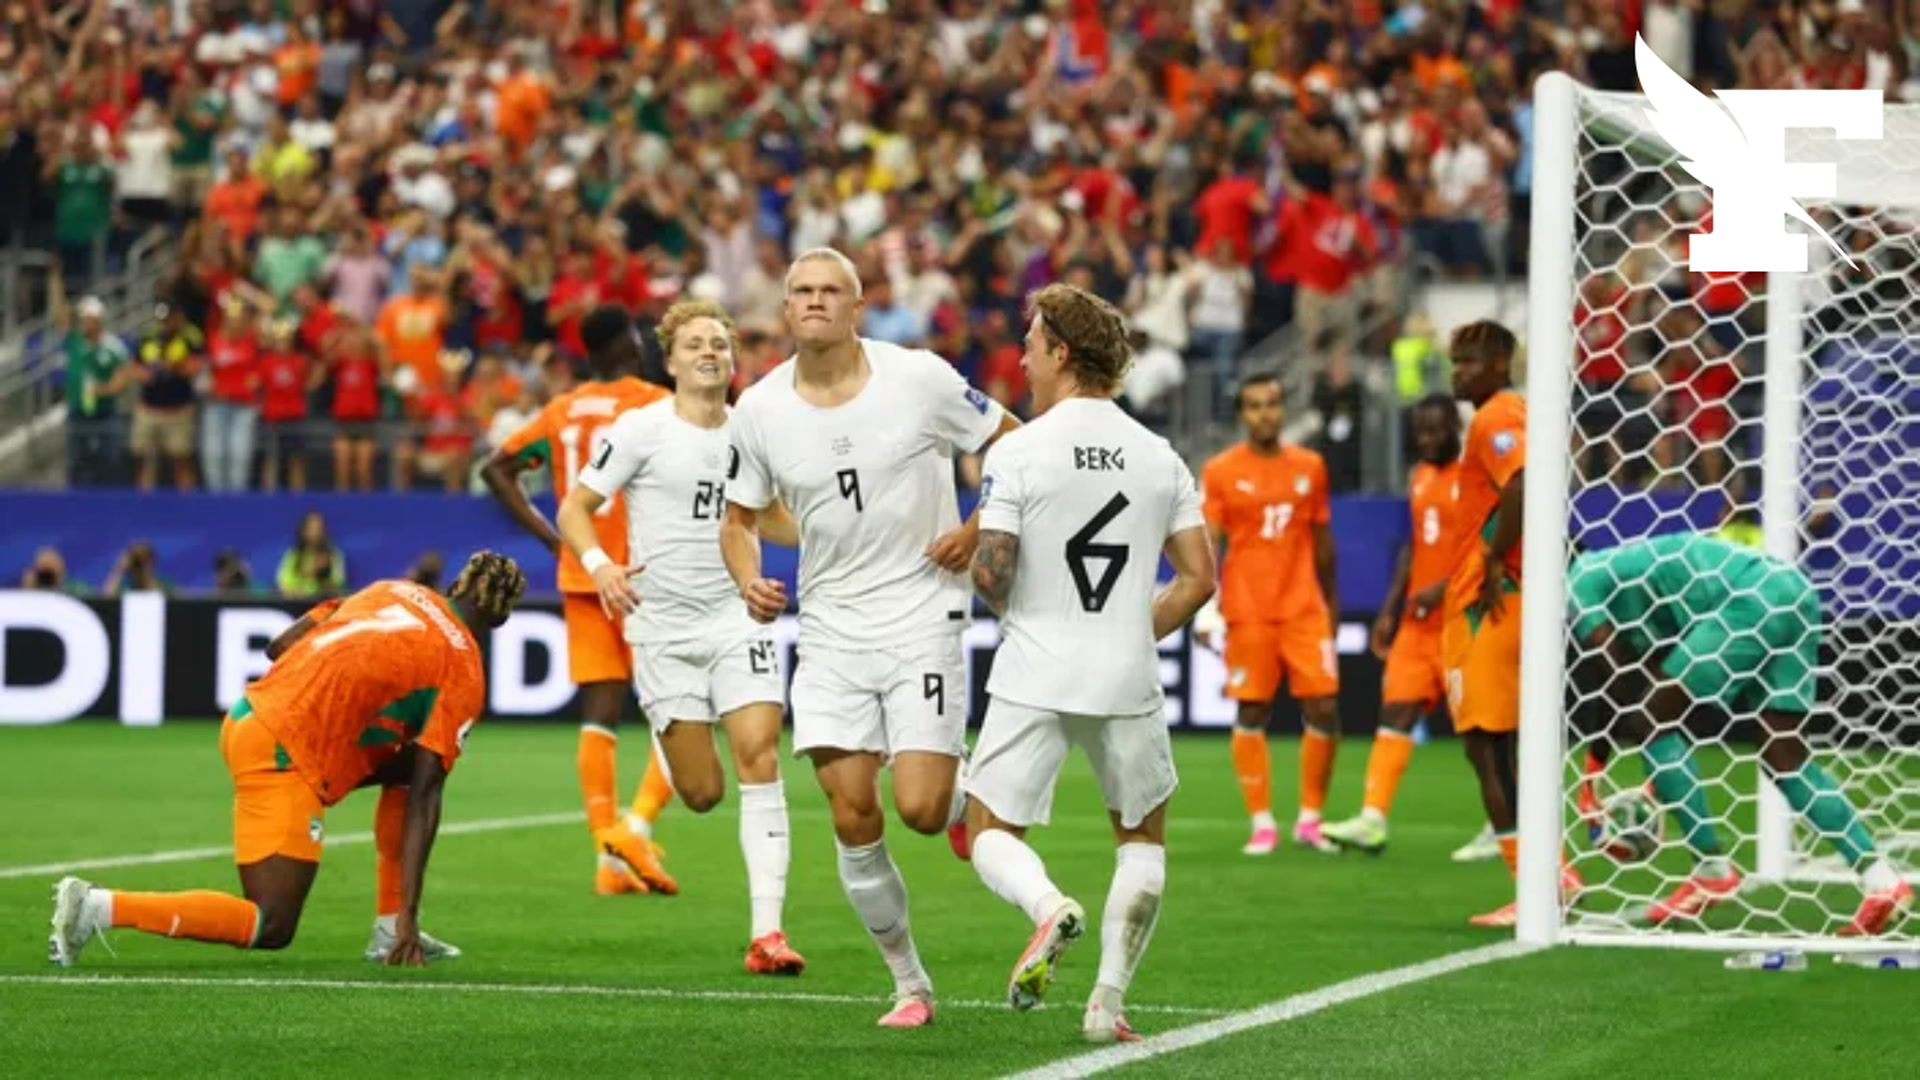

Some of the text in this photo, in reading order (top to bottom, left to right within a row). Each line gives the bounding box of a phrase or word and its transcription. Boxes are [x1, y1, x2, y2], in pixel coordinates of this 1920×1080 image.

[1073, 446, 1125, 471] BERG
[837, 468, 863, 513] 9
[1065, 490, 1131, 613] 6
[924, 672, 945, 716] 9
